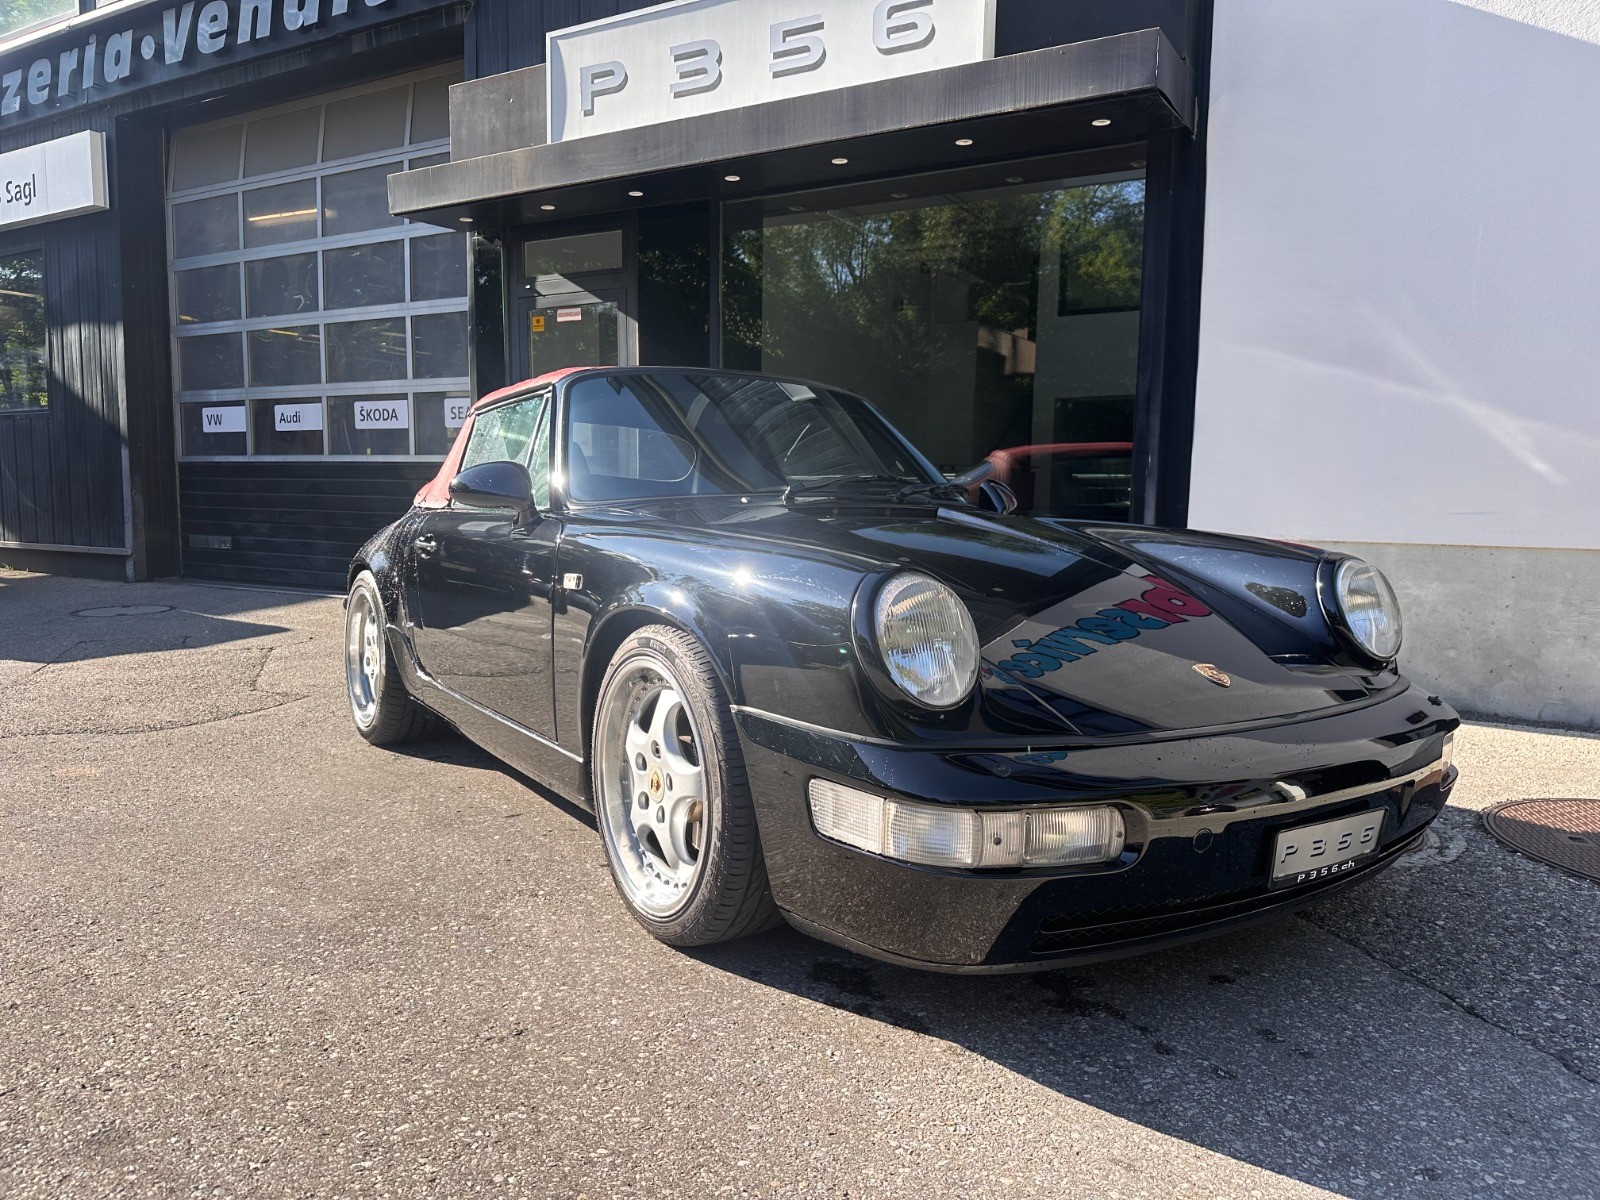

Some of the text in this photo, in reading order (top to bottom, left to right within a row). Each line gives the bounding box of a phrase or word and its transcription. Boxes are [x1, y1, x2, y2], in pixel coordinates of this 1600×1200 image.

[6, 174, 36, 206] Sagl
[206, 413, 223, 426] VW
[279, 410, 301, 424] Audi
[359, 405, 399, 422] ŠKODA
